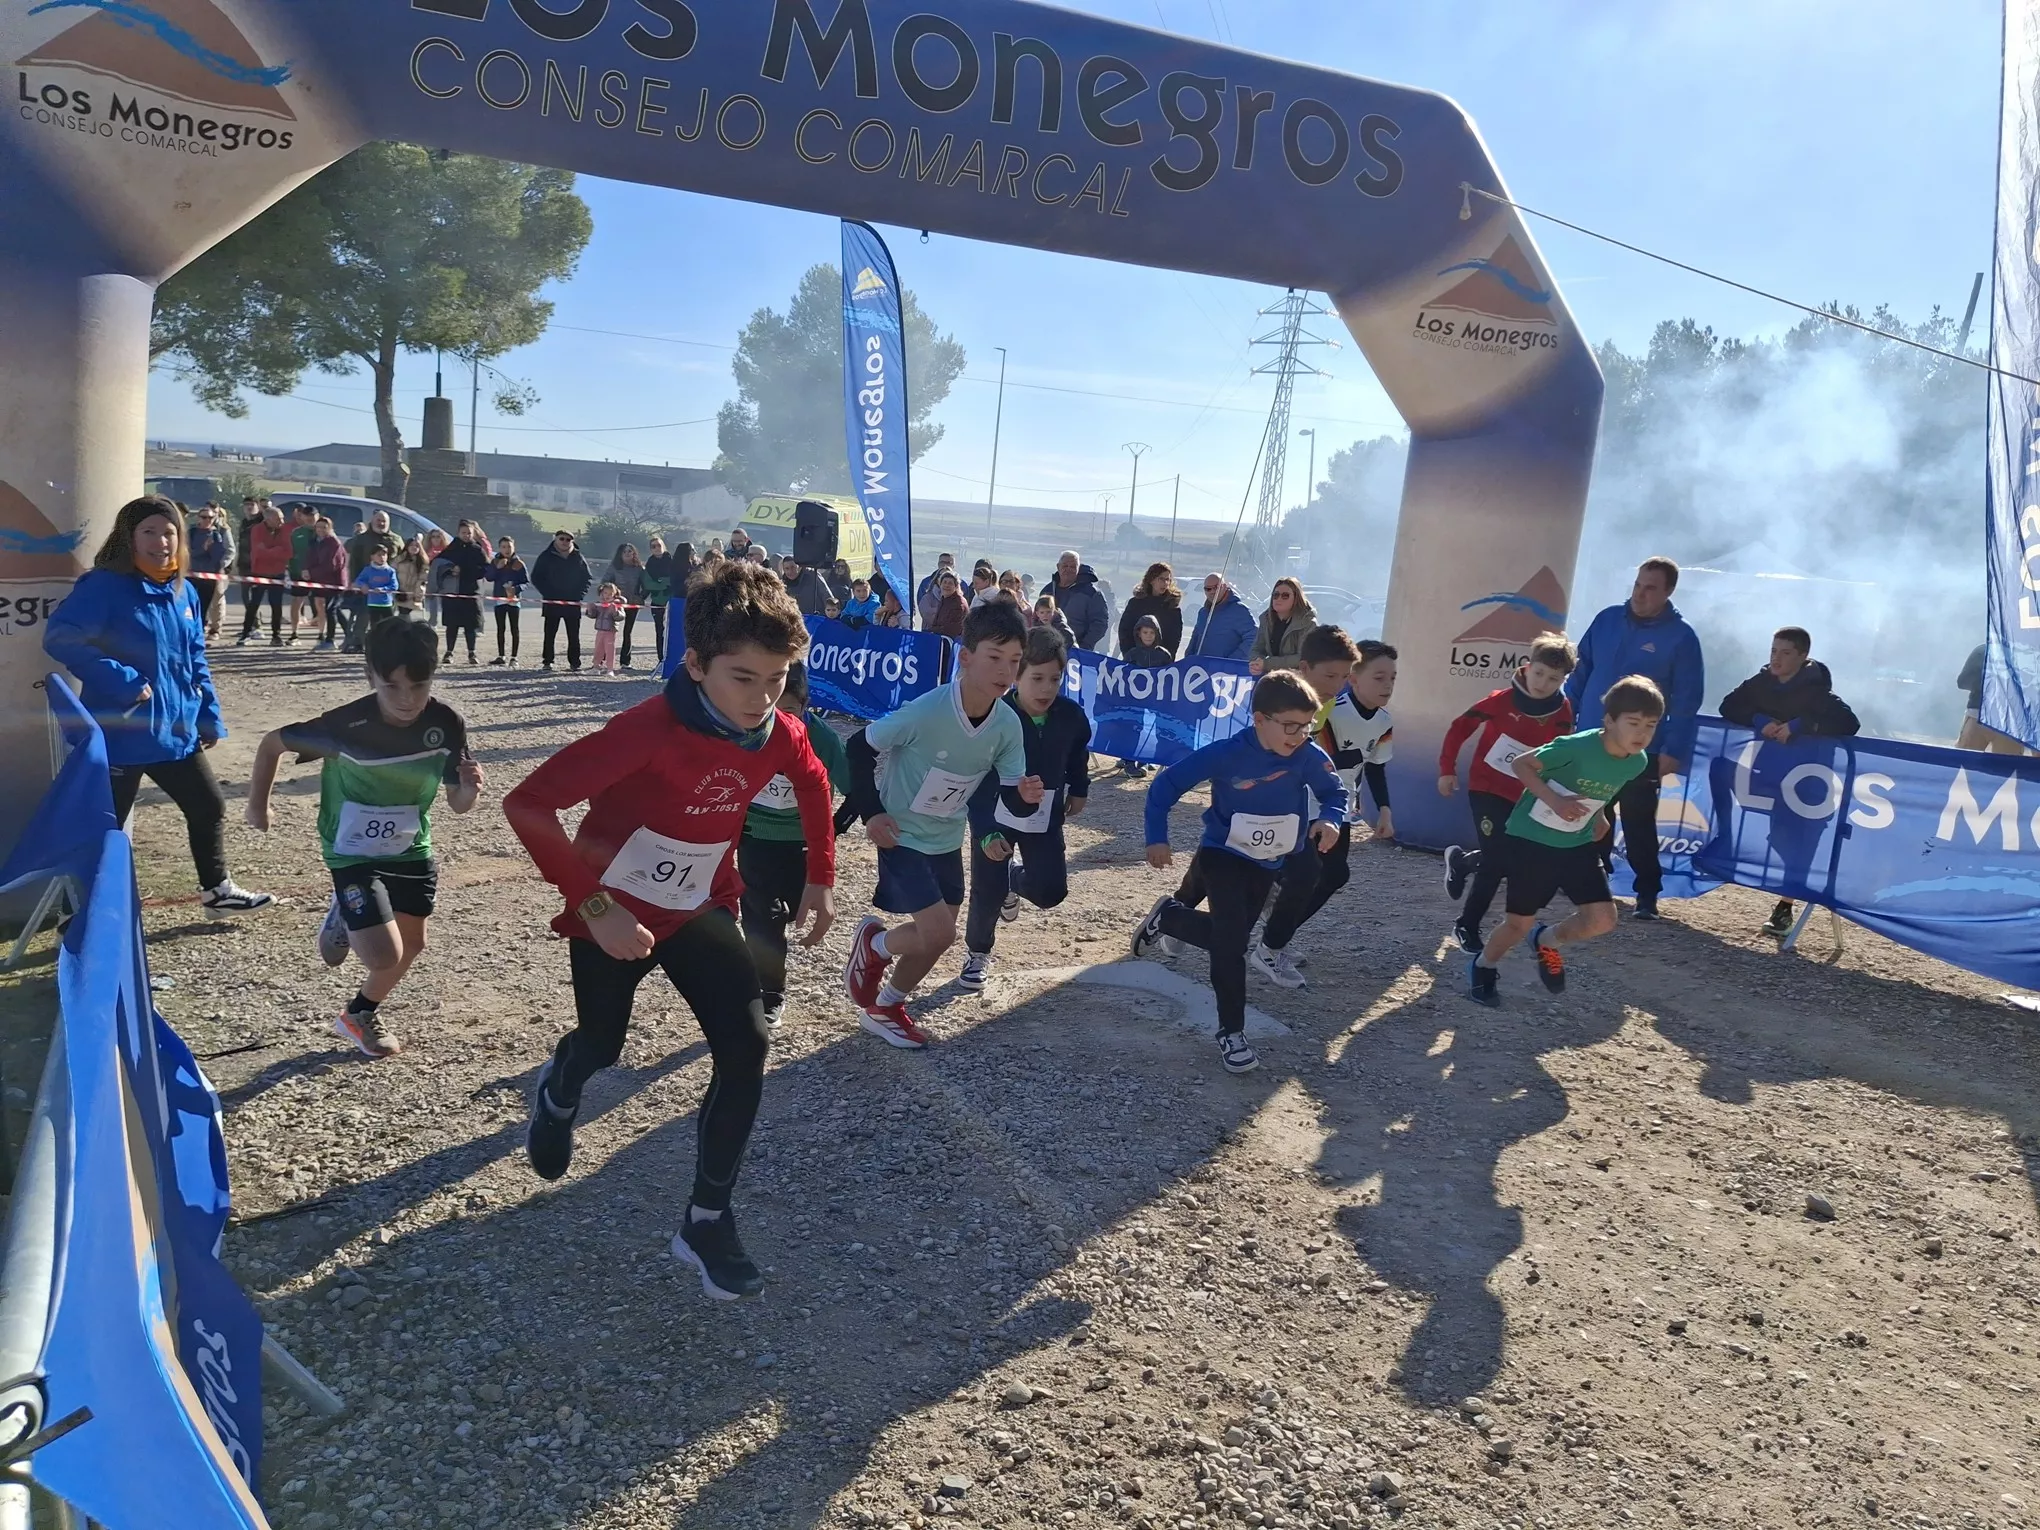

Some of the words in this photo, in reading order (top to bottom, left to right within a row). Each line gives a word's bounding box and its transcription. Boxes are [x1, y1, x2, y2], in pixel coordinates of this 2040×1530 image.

[19, 71, 92, 115] Los
[109, 92, 294, 150] Monegros
[760, 0, 1404, 199] Monegros
[20, 106, 113, 137] CONSEJO
[121, 127, 218, 157] COMARCAL
[410, 37, 766, 151] CONSEJO
[795, 108, 1131, 218] COMARCAL
[1412, 329, 1461, 348] CONSEJO
[1463, 341, 1517, 356] COMARCAL
[1415, 312, 1455, 336] Los
[1461, 321, 1558, 351] Monegros
[849, 528, 868, 553] DYA
[809, 642, 918, 686] onegros
[1450, 647, 1491, 668] Los
[1449, 667, 1500, 680] CONSEJO
[1097, 658, 1255, 718] Monegr
[694, 774, 712, 795] CLUB
[714, 768, 748, 791] ATLETISMO
[768, 782, 792, 798] 87
[942, 787, 966, 803] 71
[1734, 740, 1896, 830] Los
[684, 805, 711, 815] SAN
[711, 803, 740, 813] JOSE
[365, 820, 396, 839] 88
[1251, 829, 1275, 846] 99
[651, 861, 694, 888] 91
